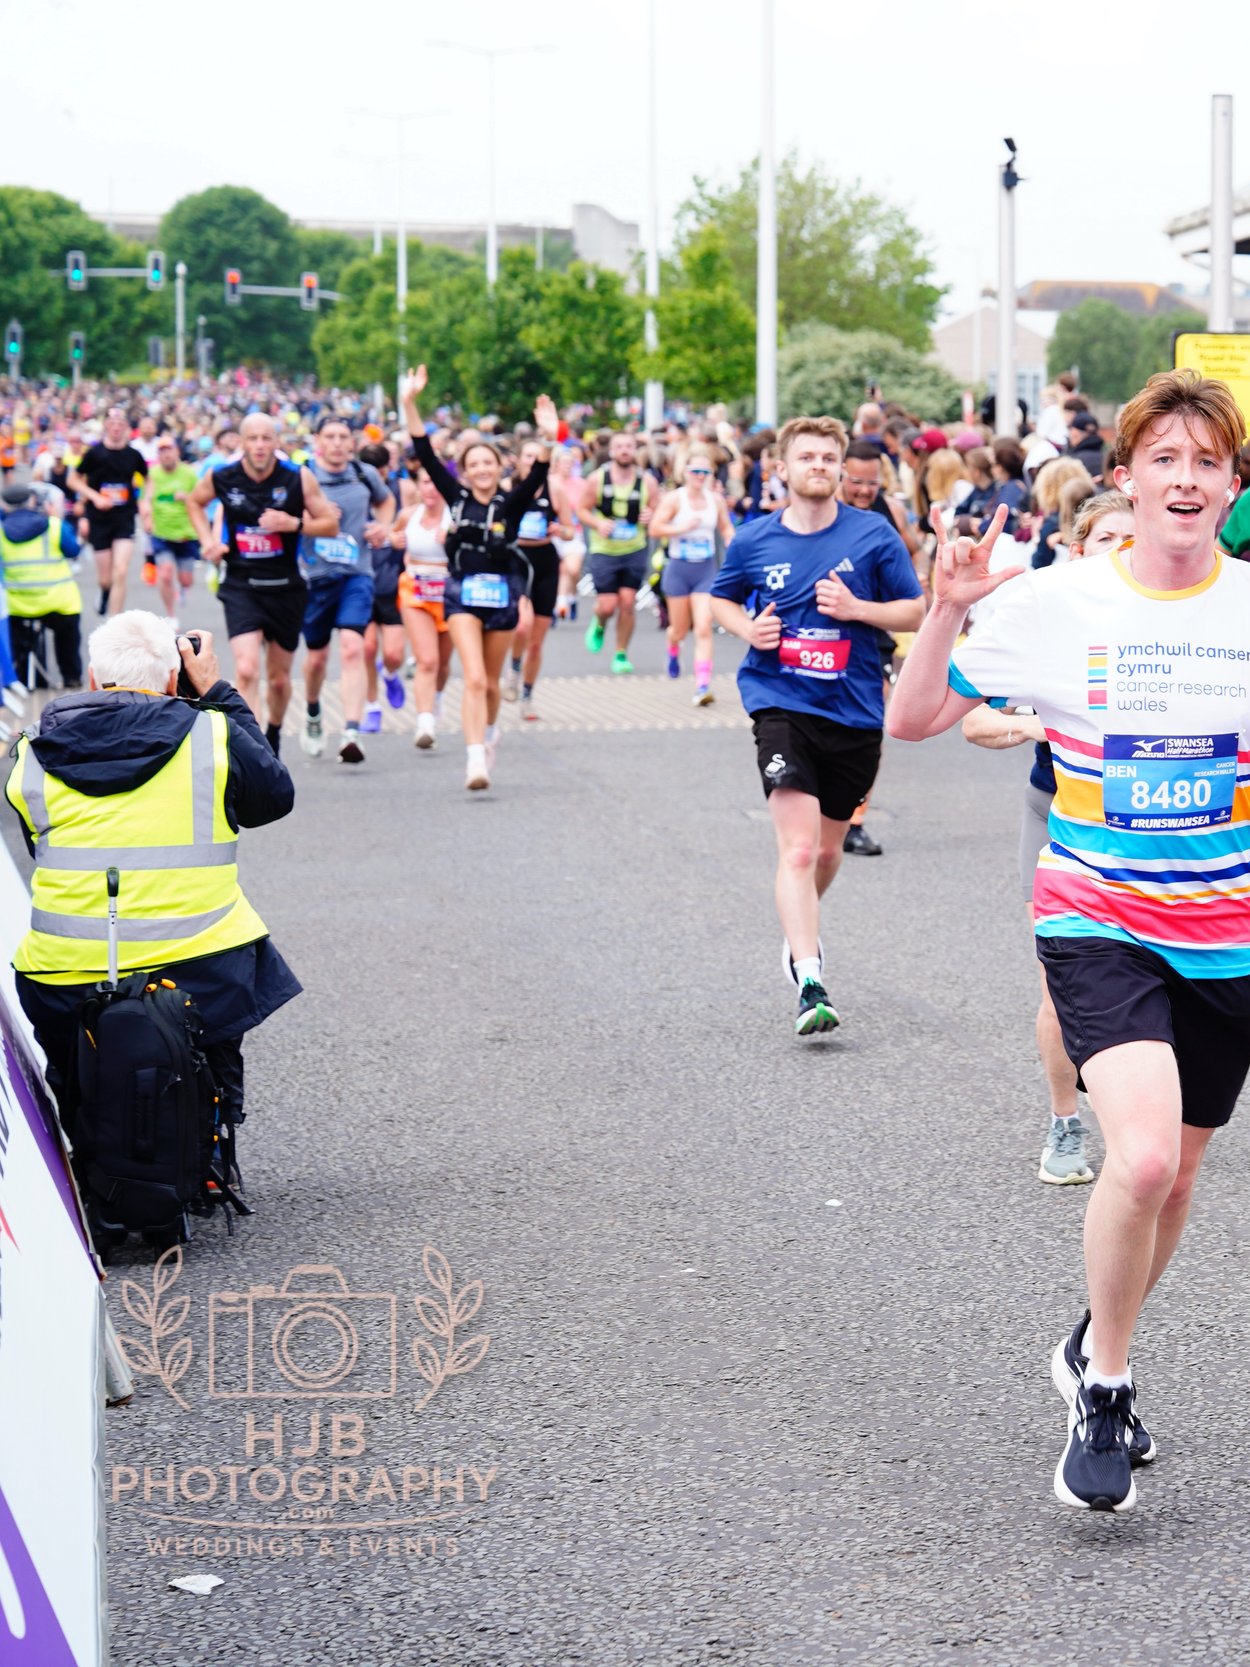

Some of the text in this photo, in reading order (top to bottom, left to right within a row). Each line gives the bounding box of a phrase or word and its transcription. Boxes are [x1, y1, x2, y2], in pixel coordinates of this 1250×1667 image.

[1117, 641, 1192, 659] ymchwil
[799, 650, 835, 670] 926
[1116, 662, 1172, 677] cymru
[1116, 680, 1247, 699] cancer research
[1117, 697, 1168, 712] wales
[1167, 738, 1214, 748] SWANSEA
[1105, 765, 1137, 778] BEN
[1130, 778, 1212, 810] 8480
[1130, 815, 1210, 829] #RUNSWANSEA
